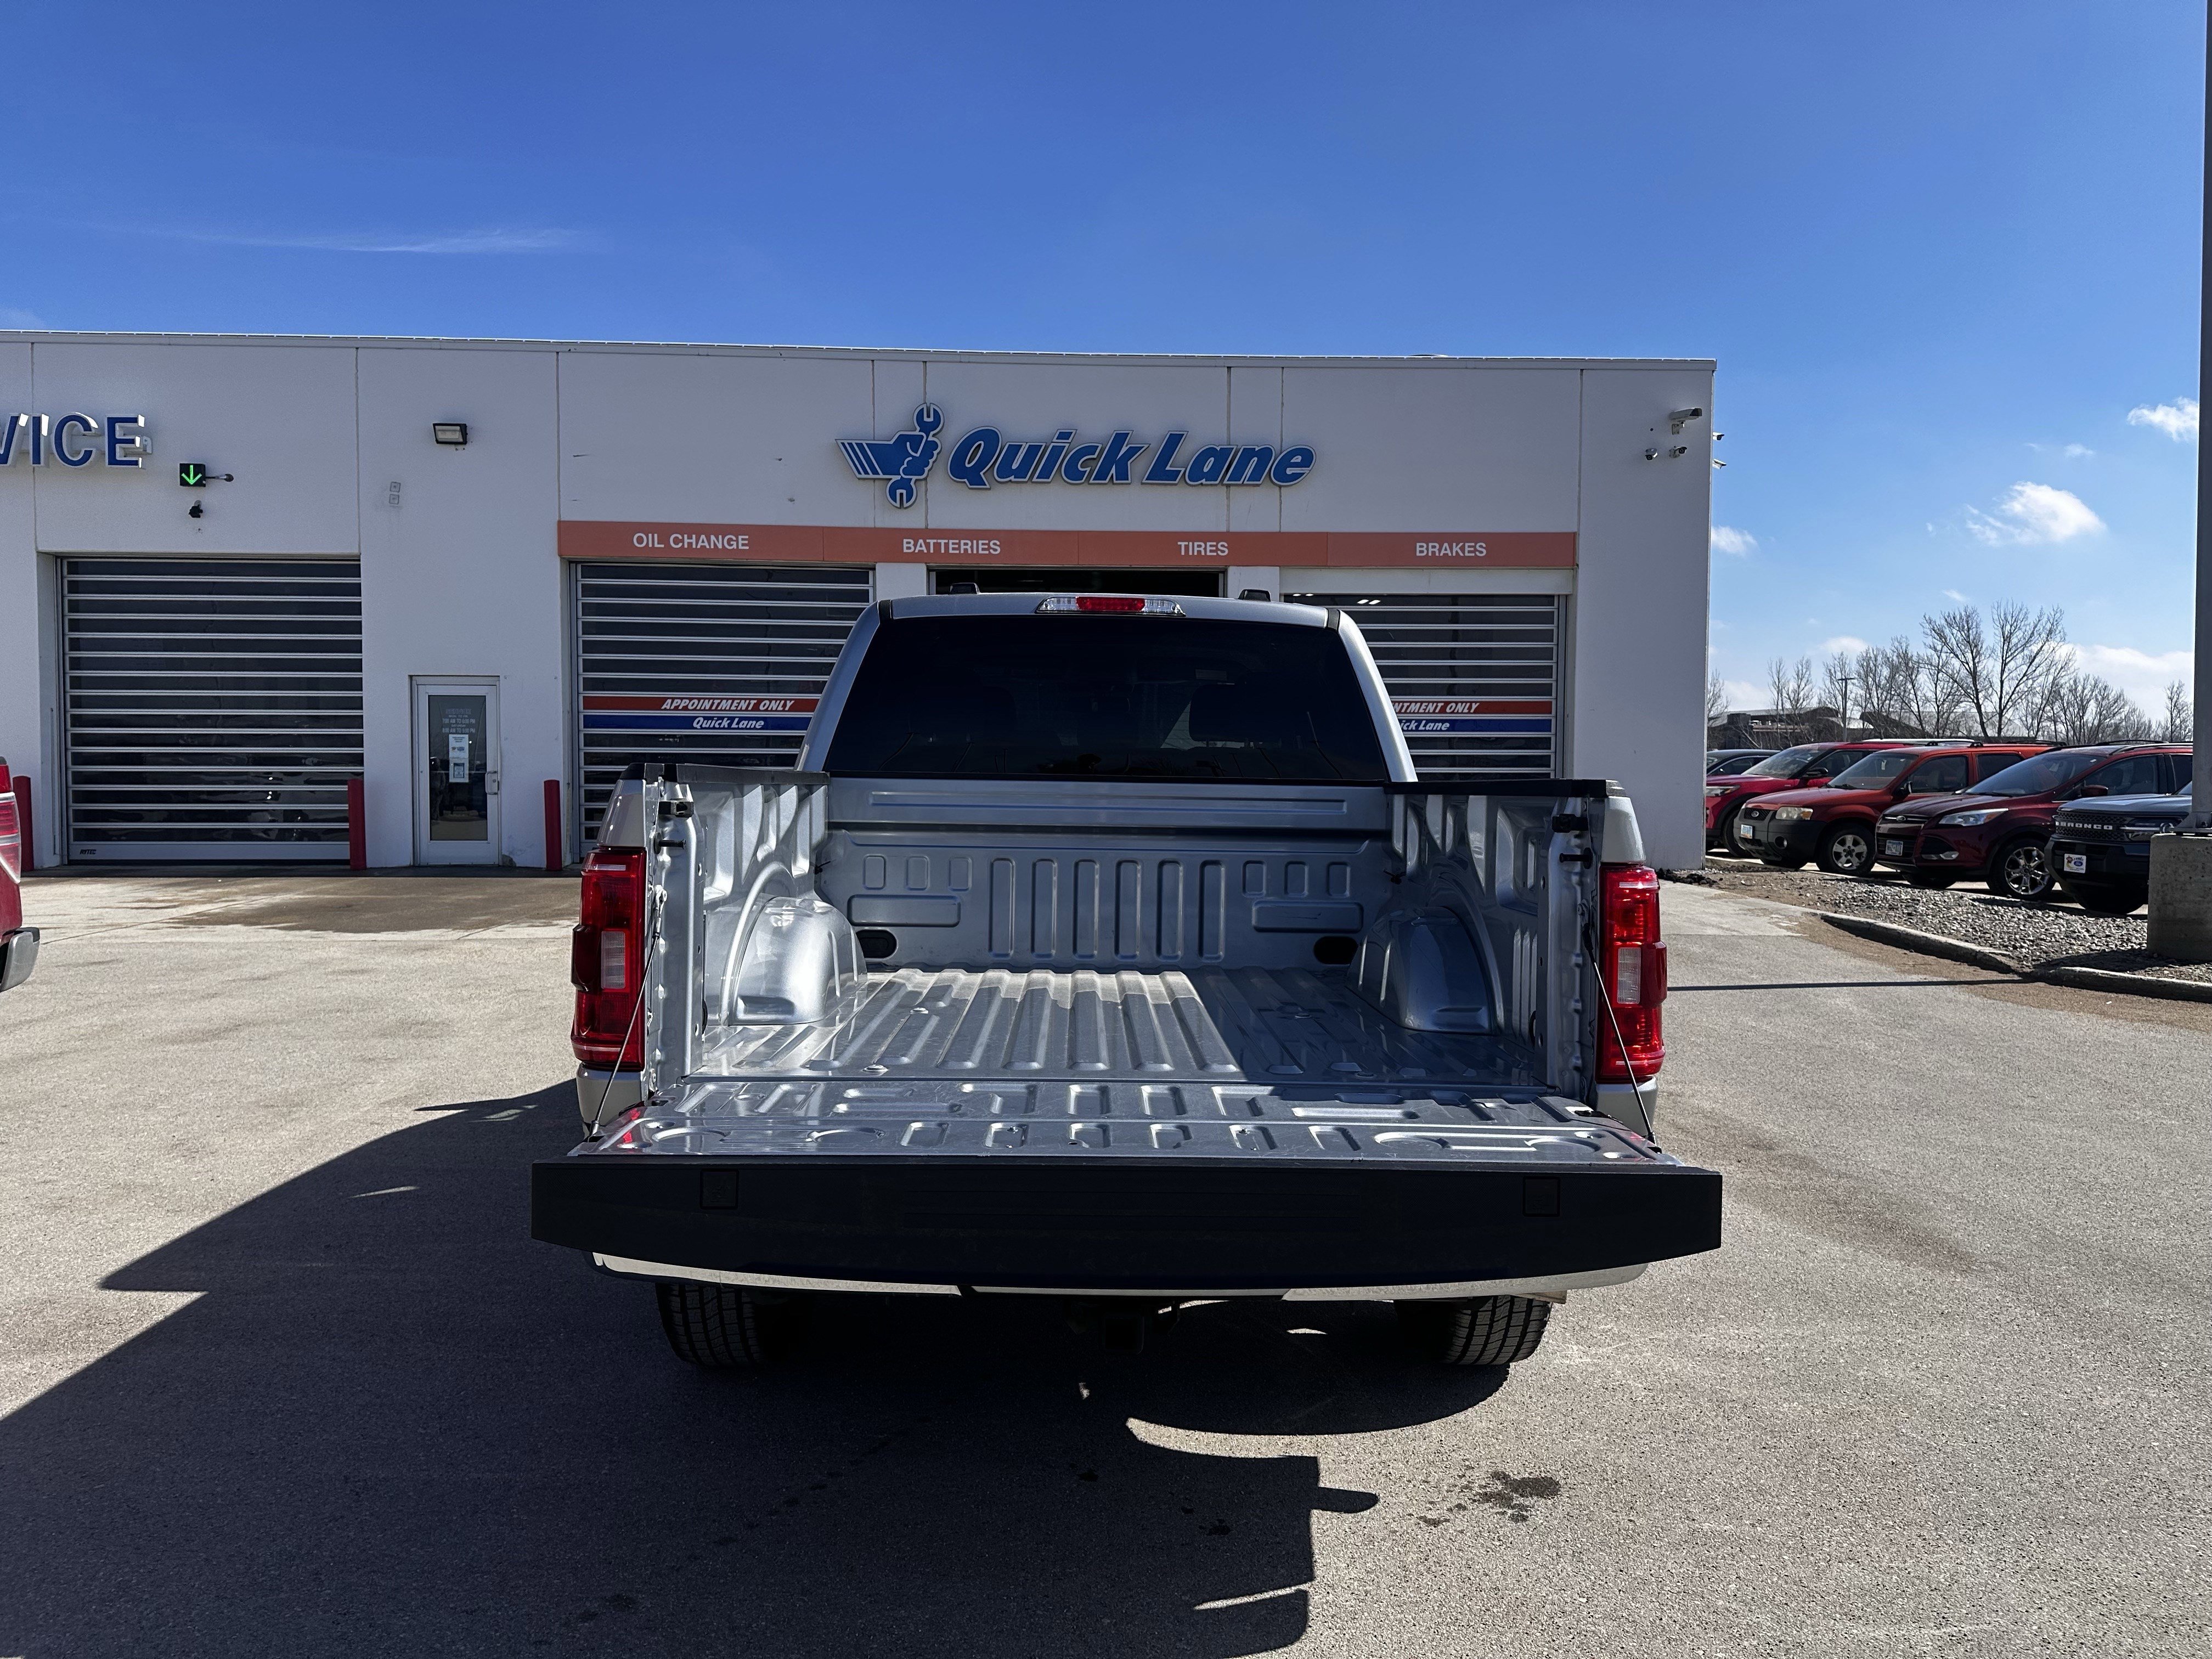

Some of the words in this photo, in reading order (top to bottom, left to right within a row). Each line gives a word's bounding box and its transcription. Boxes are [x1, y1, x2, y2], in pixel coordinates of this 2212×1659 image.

[947, 426, 1148, 489] Quick
[1142, 431, 1316, 486] Lane
[633, 533, 664, 548] OIL
[669, 534, 749, 550] CHANGE
[903, 539, 1001, 555] BATTERIES
[1177, 541, 1228, 556] TIRES
[1416, 543, 1486, 556] BRAKES
[661, 699, 757, 710] APPOINTMENT
[759, 700, 794, 711] ONLY
[1392, 702, 1444, 713] NTMENT
[1446, 703, 1480, 713] ONLY
[693, 717, 730, 729] Quick
[731, 718, 764, 729] Lane
[1400, 720, 1418, 730] ick
[1418, 720, 1450, 730] Lane
